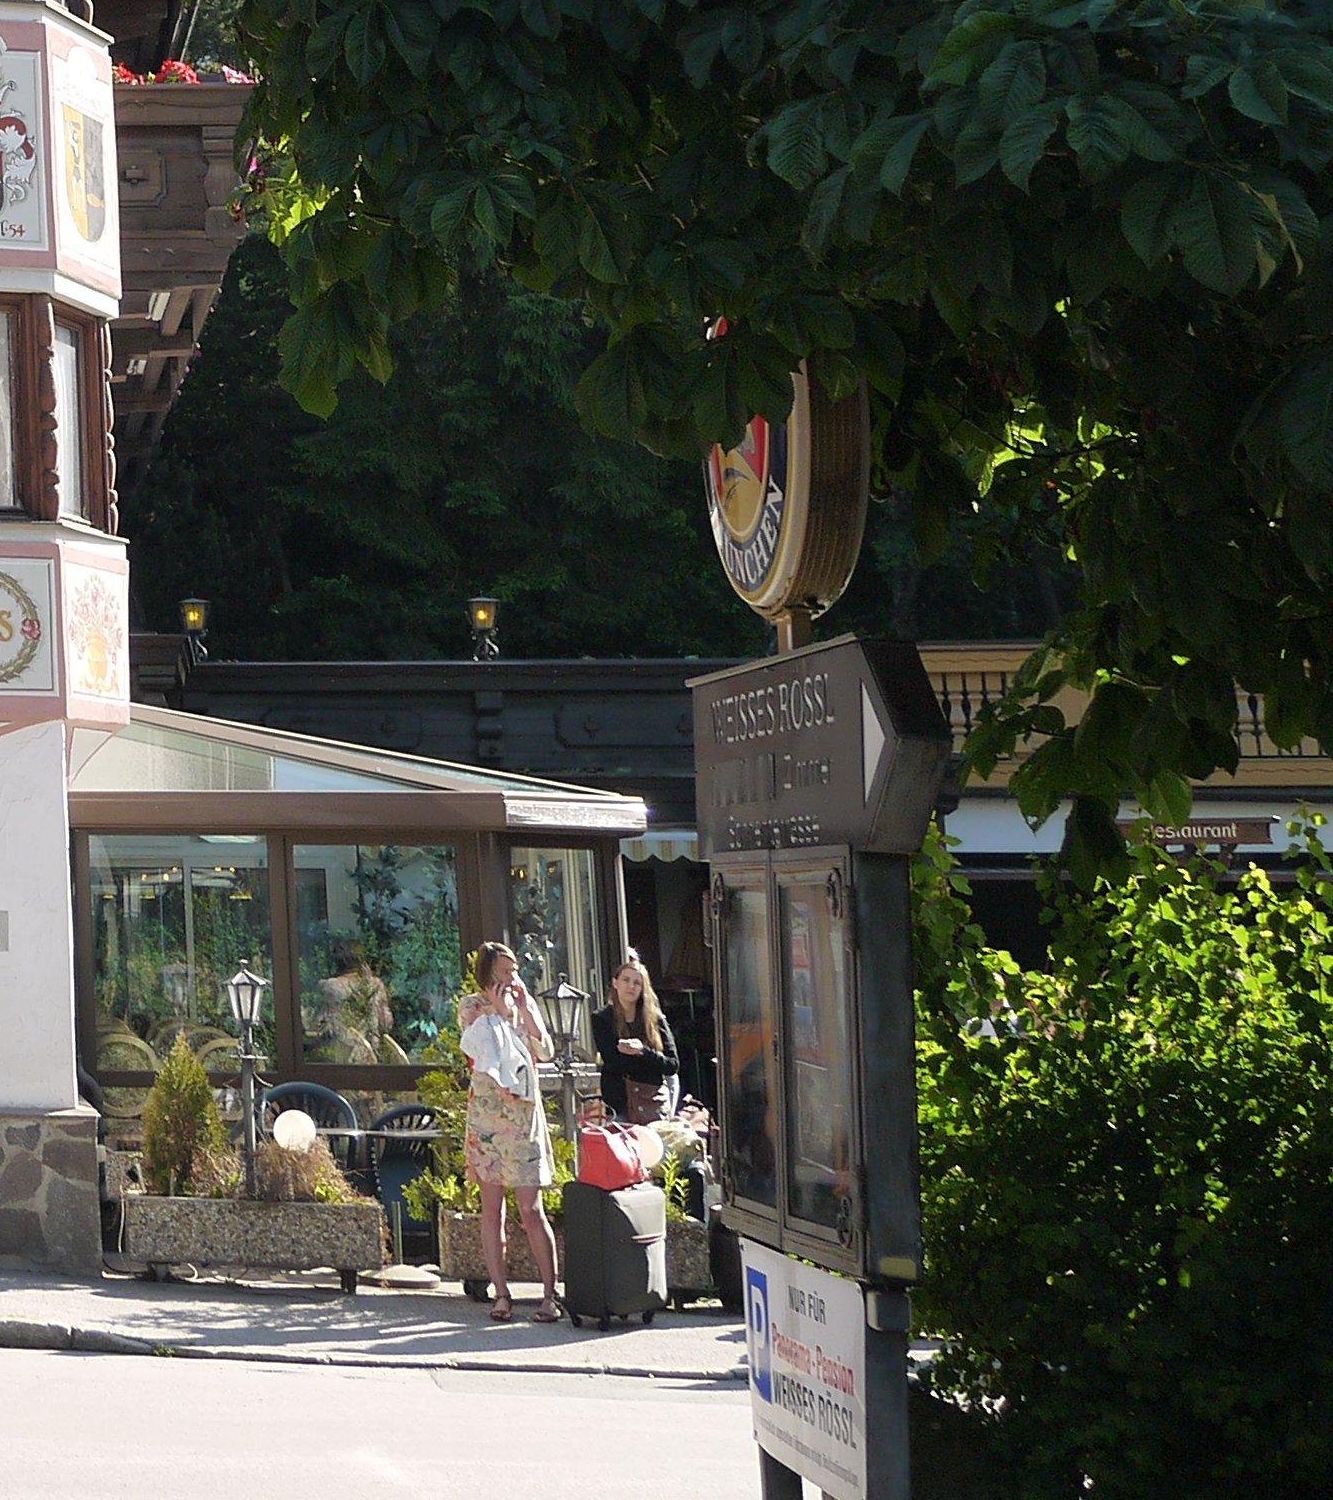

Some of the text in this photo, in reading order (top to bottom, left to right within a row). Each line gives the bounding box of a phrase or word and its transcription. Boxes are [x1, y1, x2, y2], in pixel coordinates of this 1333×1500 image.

[788, 1285, 827, 1326] NUR FÜR
[772, 1368, 858, 1450] WEISSES RÖSSL
